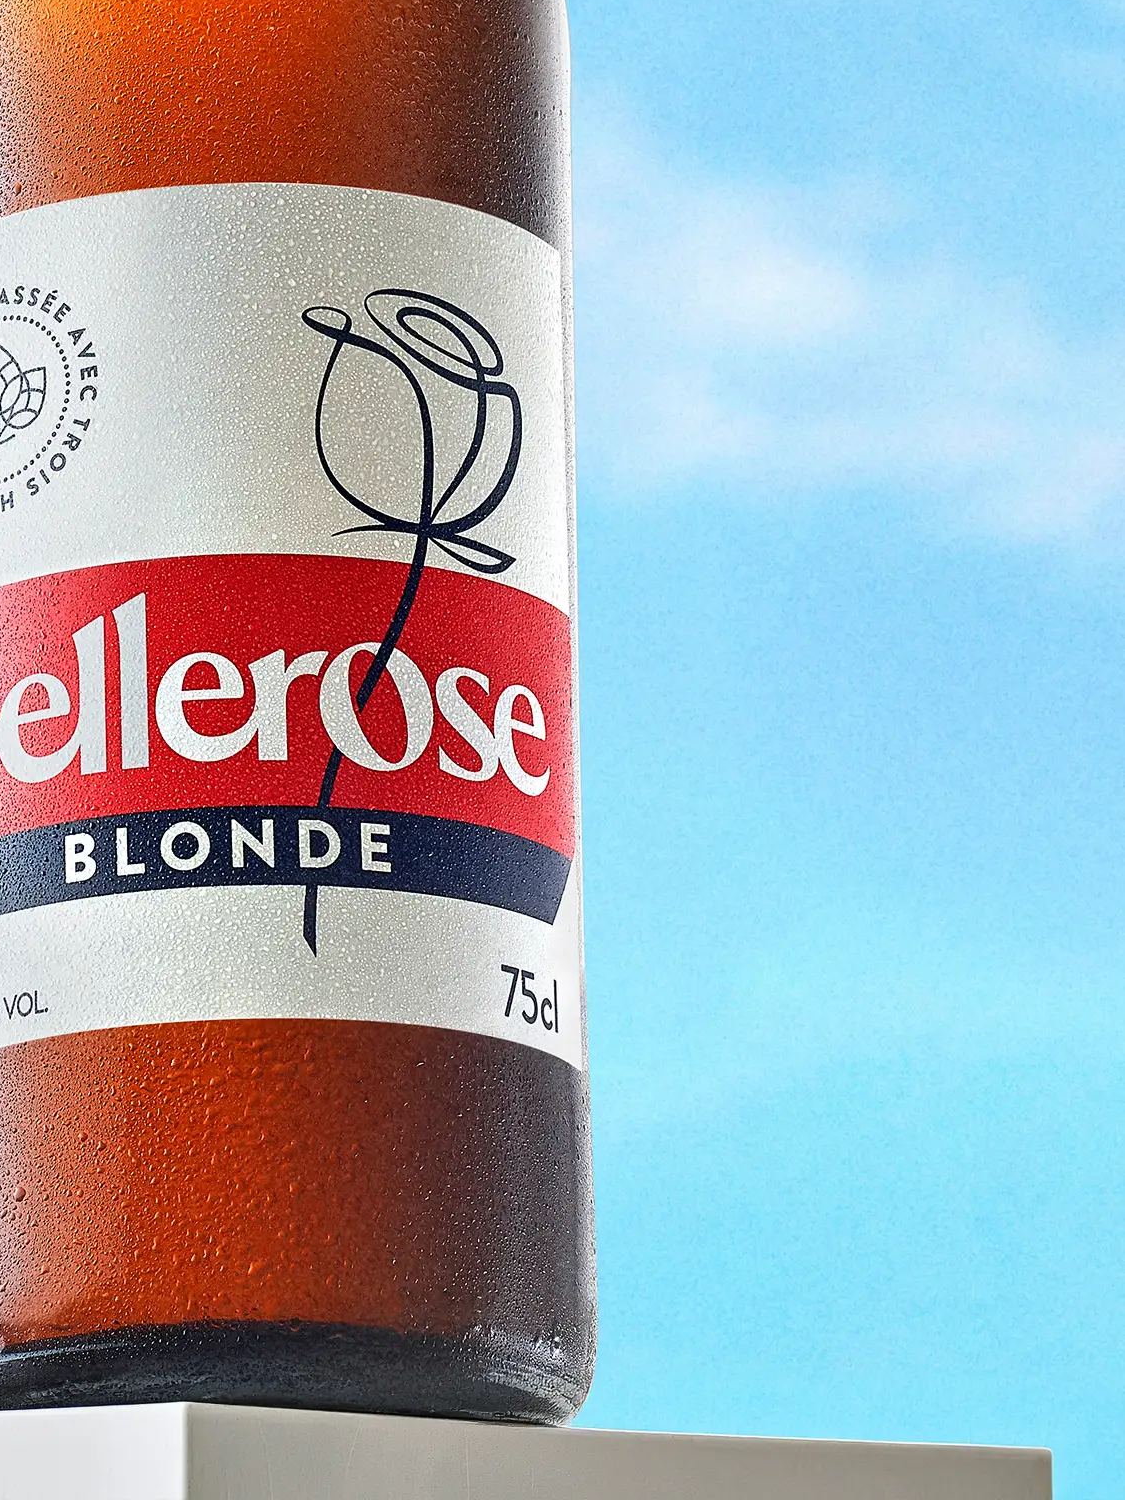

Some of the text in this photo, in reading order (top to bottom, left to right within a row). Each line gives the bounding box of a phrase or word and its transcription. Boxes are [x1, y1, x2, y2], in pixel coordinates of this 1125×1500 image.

[68, 328, 99, 401] AVEC
[26, 418, 91, 496] TROIS
[63, 818, 392, 885] BLONDE
[3, 990, 49, 1020] VOL.
[501, 964, 558, 1033] 75cl
